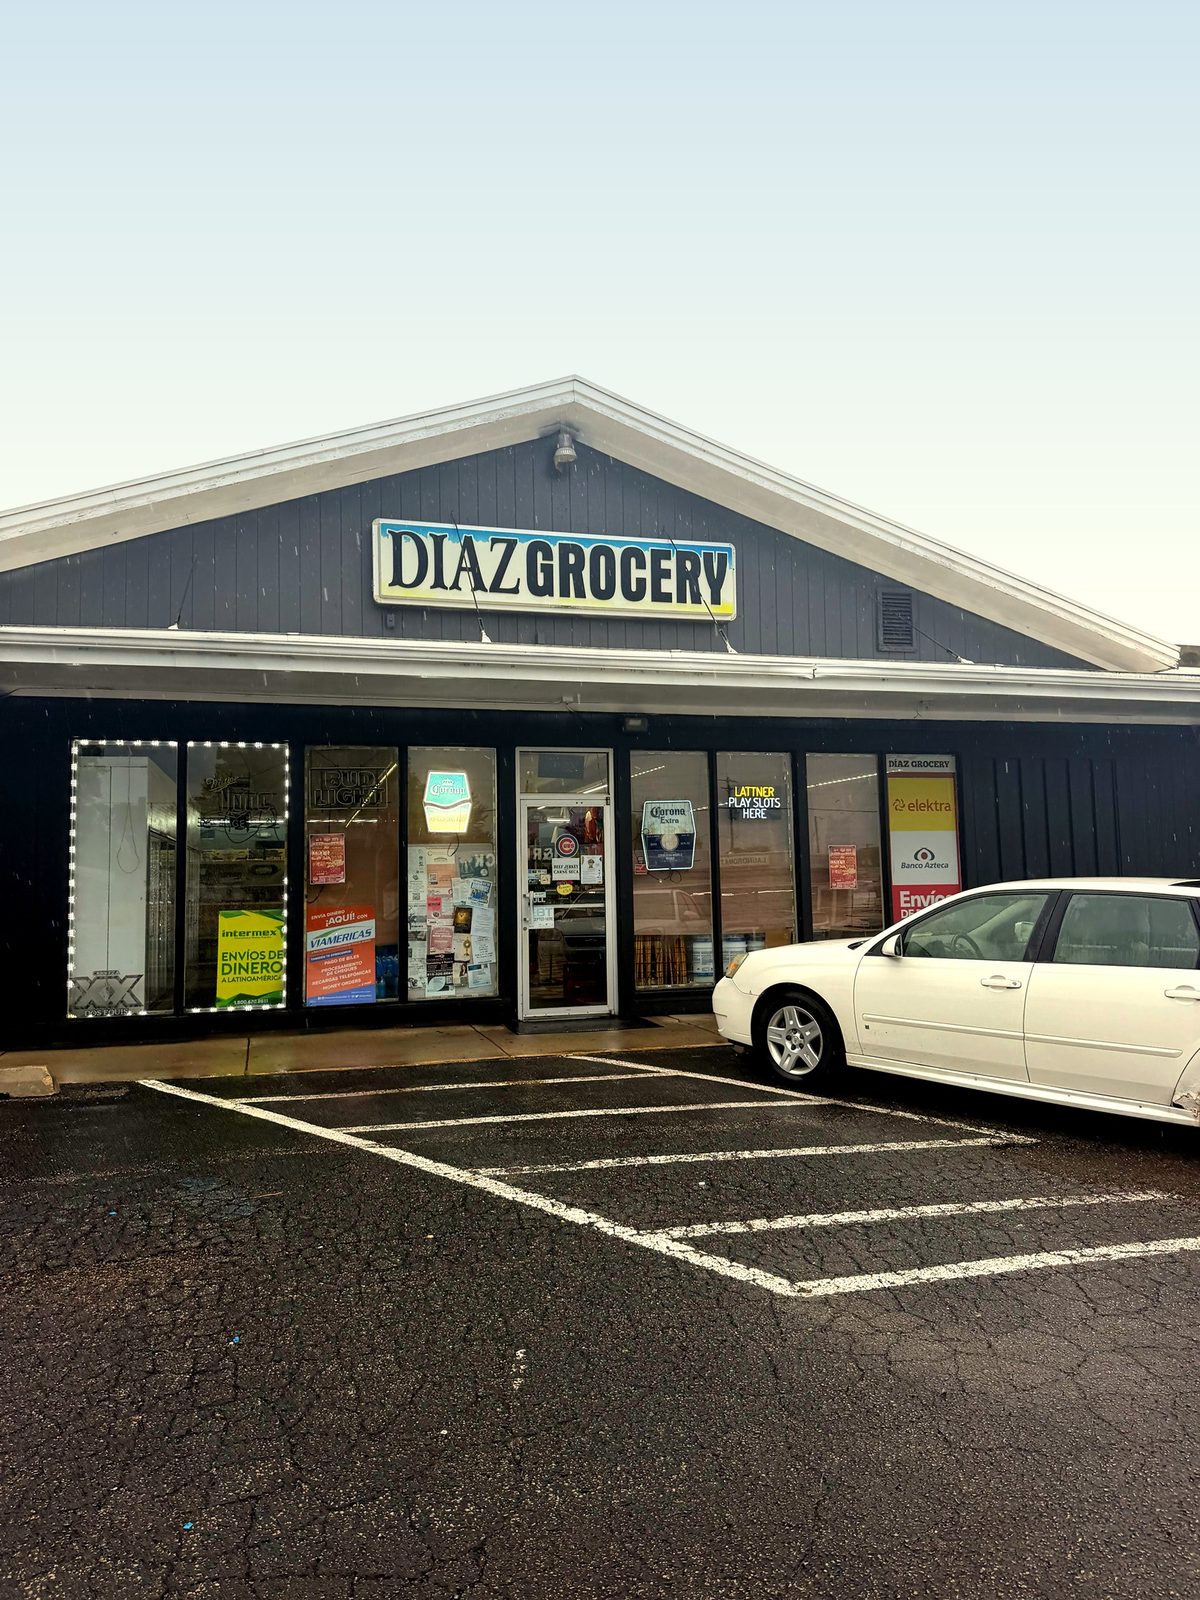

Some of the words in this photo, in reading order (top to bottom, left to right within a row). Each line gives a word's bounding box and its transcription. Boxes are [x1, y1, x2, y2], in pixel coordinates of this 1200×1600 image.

[387, 530, 520, 594] DIAZ
[526, 540, 728, 605] GROCERY
[888, 759, 910, 768] DÍAZ
[911, 760, 950, 768] GROCERY
[734, 786, 775, 797] LATTNER
[728, 797, 752, 808] PLAY
[753, 797, 781, 808] SLOTS
[908, 799, 951, 812] elektra
[650, 806, 686, 819] Corona
[743, 808, 767, 819] HERE
[660, 816, 680, 824] Extra
[310, 928, 372, 948] VIAMERICAS
[222, 949, 266, 961] ENVÍOS
[268, 950, 284, 960] DE
[222, 961, 283, 976] DINERO
